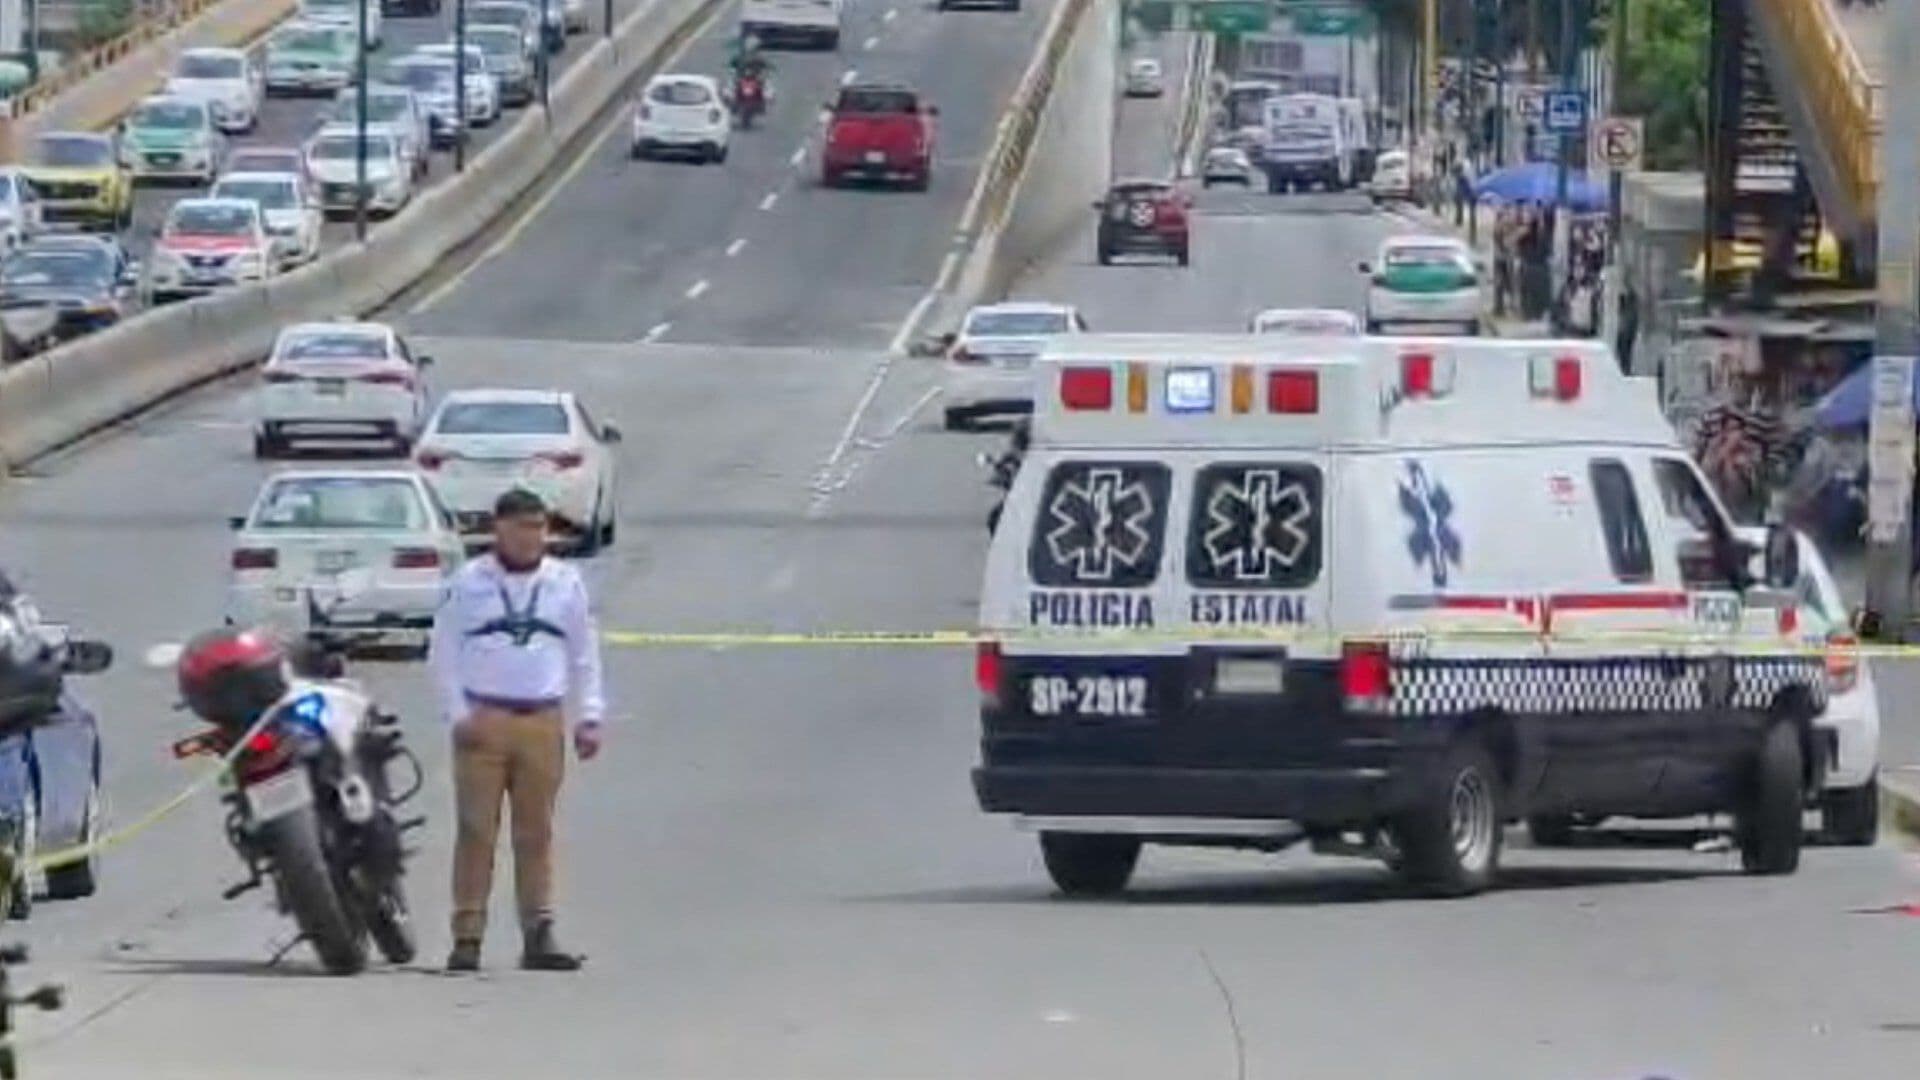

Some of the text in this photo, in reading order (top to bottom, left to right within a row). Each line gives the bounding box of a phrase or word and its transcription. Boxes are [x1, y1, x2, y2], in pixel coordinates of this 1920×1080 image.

[1029, 591, 1308, 626] POLICIA ESTATAL
[1031, 676, 1147, 715] SP-2912
